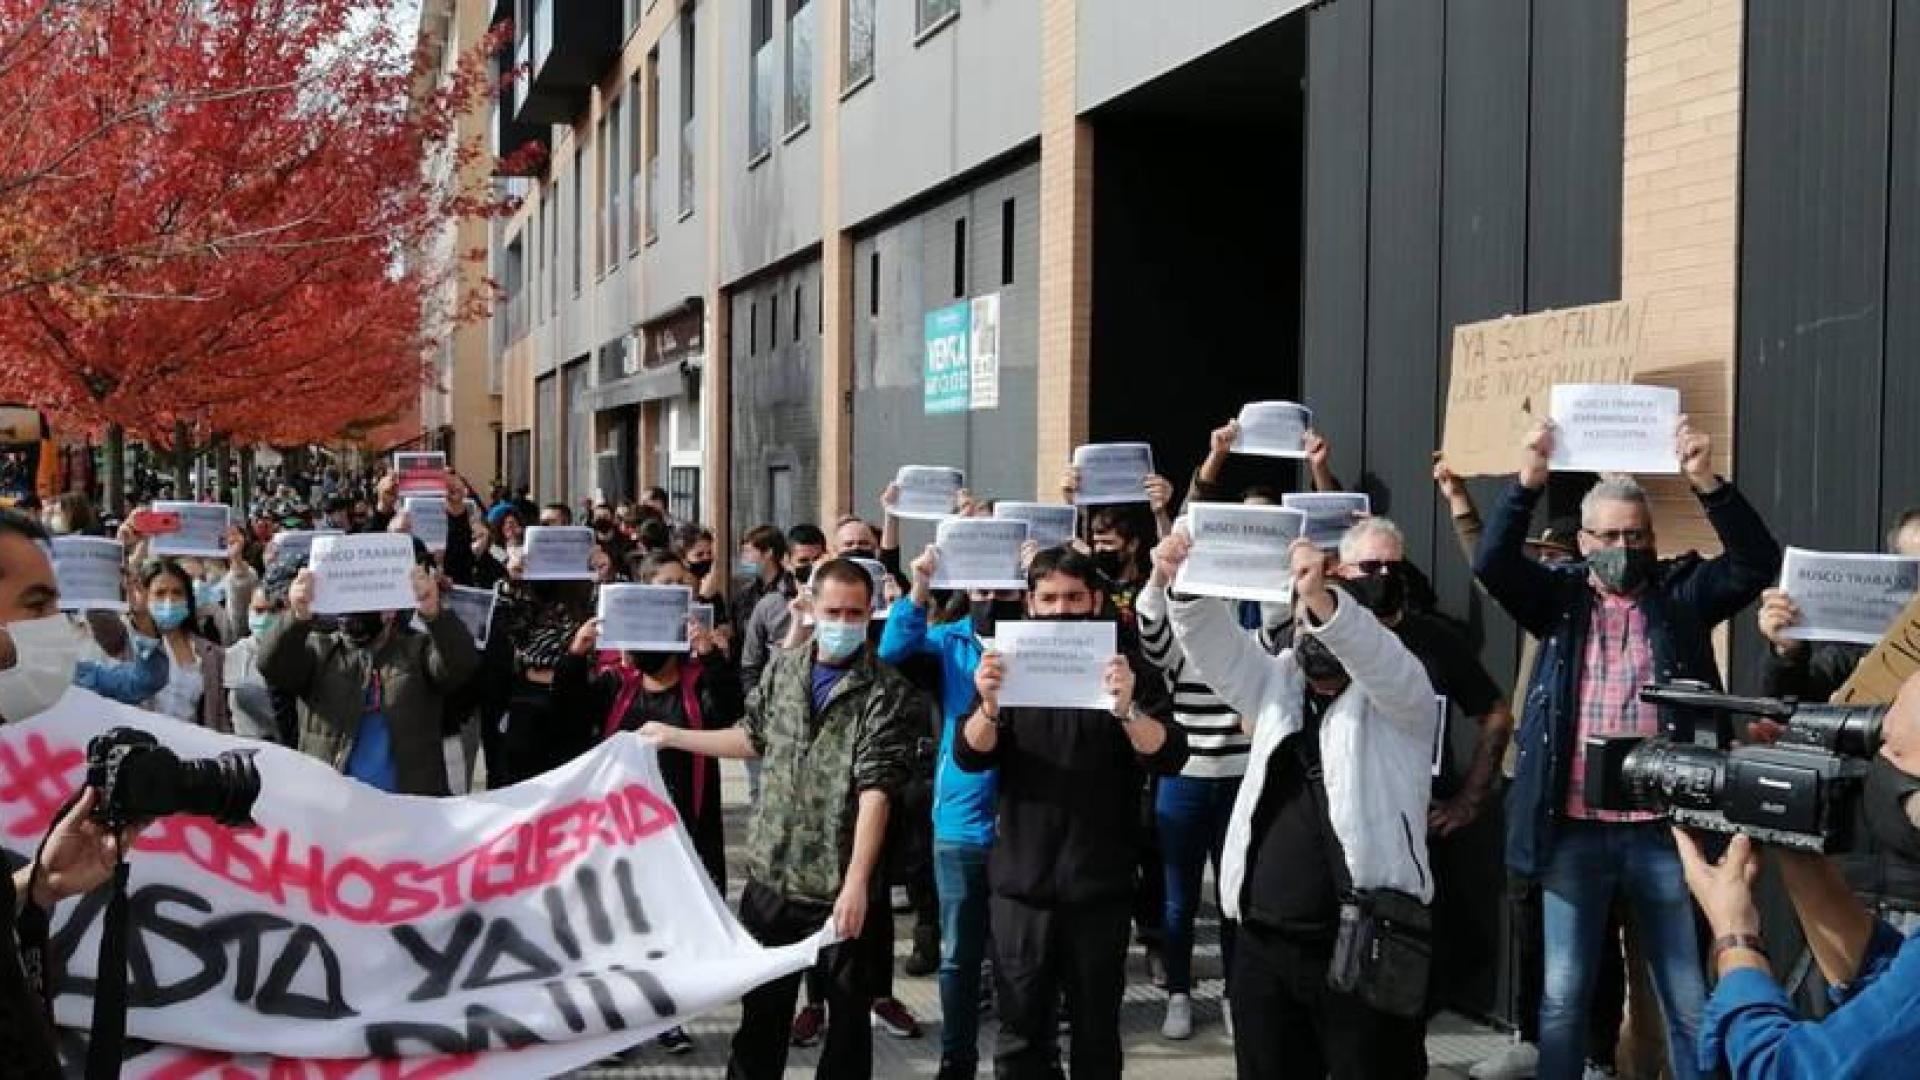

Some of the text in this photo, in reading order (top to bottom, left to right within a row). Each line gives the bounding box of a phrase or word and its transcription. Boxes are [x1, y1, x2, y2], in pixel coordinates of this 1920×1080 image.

[1462, 331, 1488, 371] YA
[1491, 316, 1557, 362] SOLO
[1797, 567, 1910, 586] BUSCO TRABAJO
[45, 882, 360, 1019] ASTA
